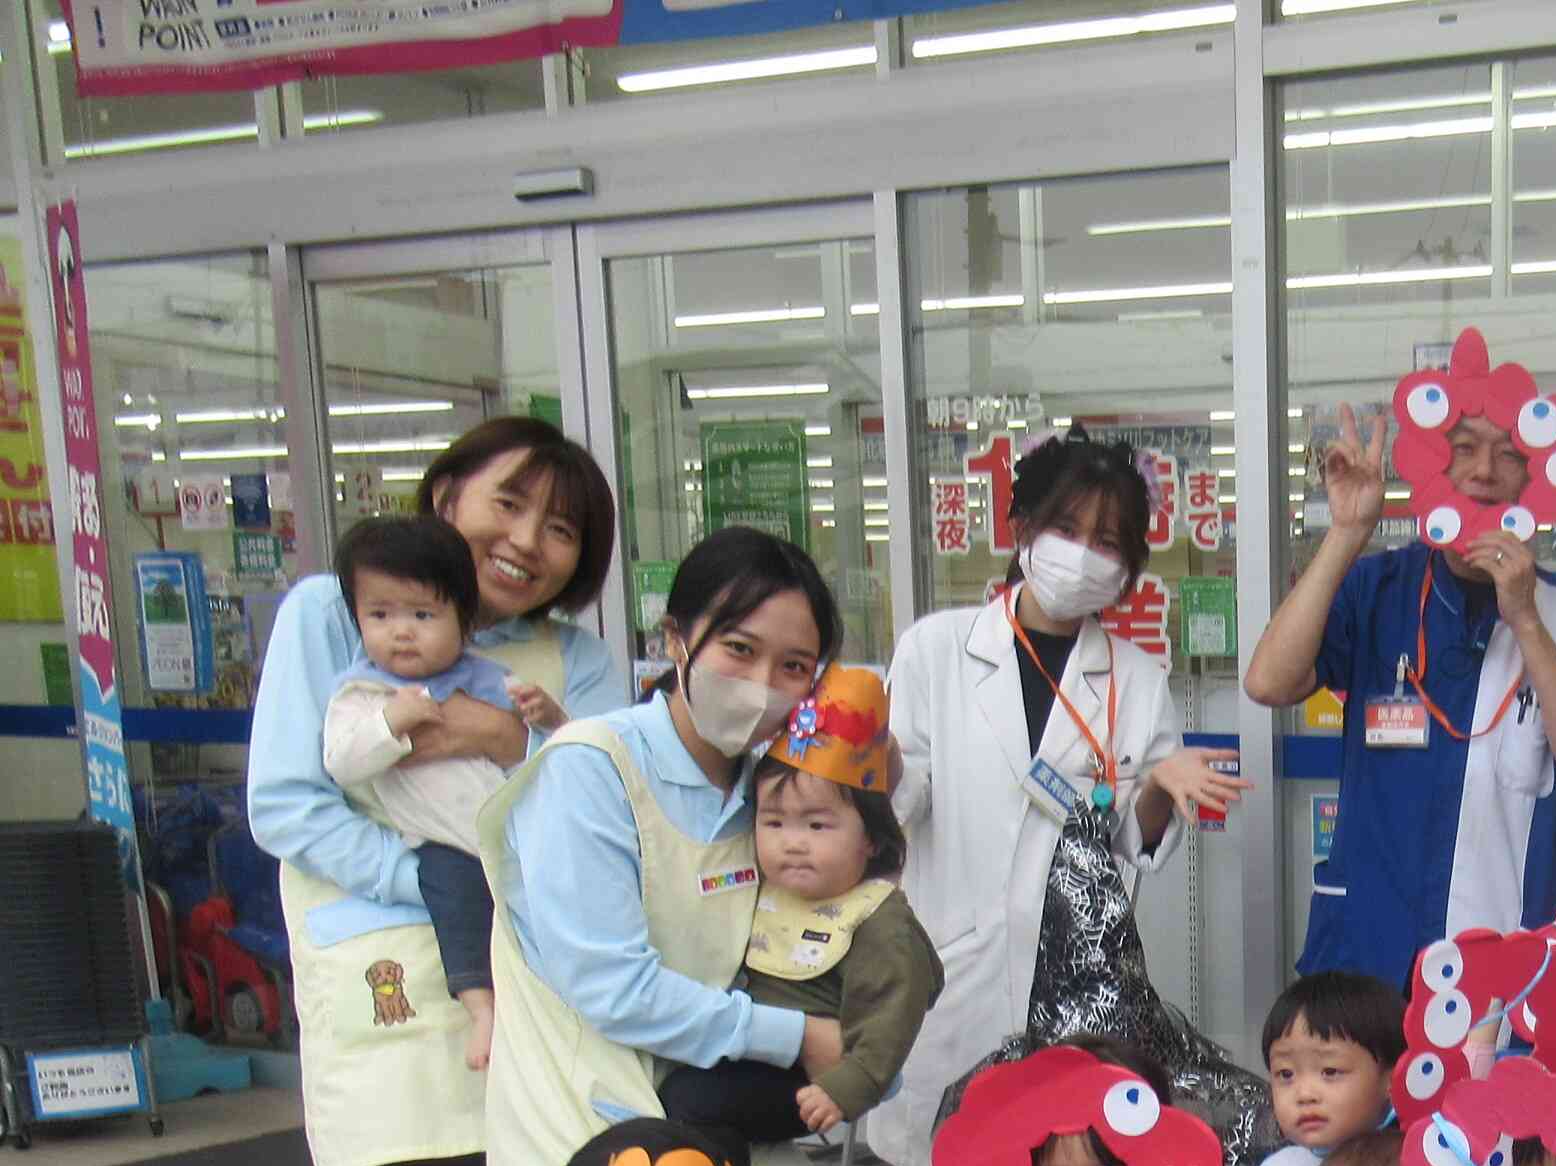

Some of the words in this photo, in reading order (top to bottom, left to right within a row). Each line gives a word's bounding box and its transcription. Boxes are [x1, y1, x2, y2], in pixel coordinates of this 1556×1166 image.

[138, 19, 211, 51] POINT
[936, 481, 967, 552] 深夜
[1187, 470, 1219, 548] まで
